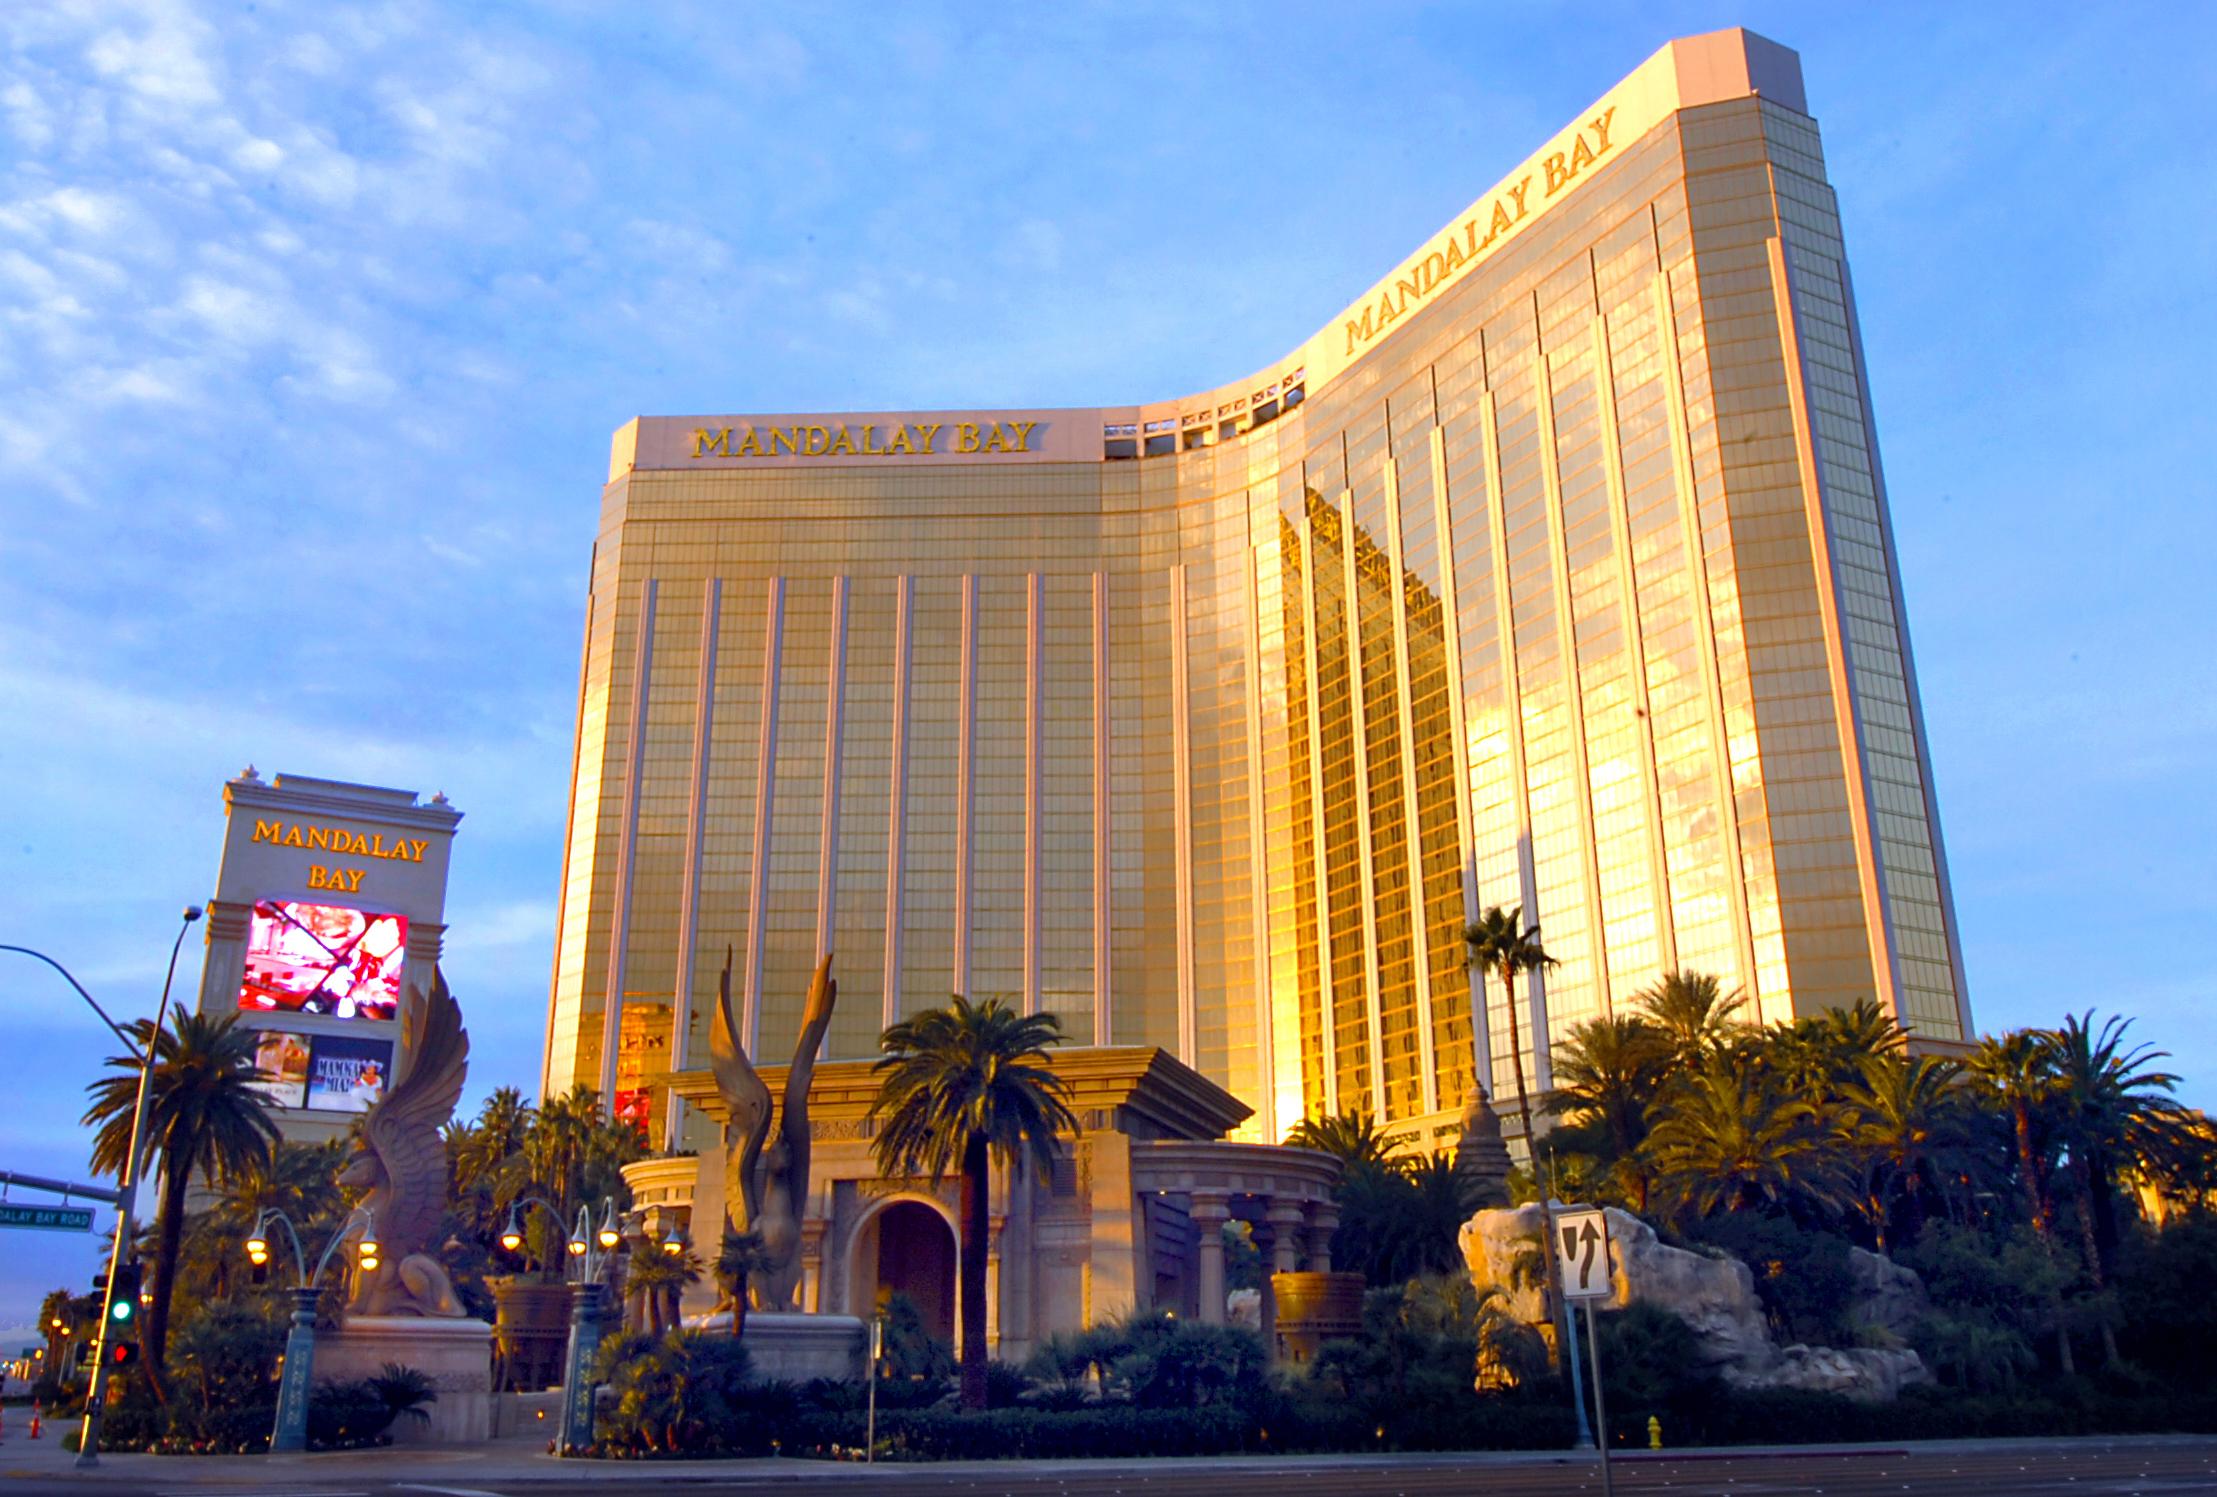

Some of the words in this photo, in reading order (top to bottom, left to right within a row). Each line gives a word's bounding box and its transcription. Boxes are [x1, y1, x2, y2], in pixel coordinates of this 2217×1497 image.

[1344, 174, 1533, 356] MANDALAY
[1541, 105, 1616, 198] BAY
[691, 423, 941, 458] MANDALAY
[954, 421, 1038, 453] BAY
[252, 819, 428, 862] MANDALAY
[307, 864, 366, 892] BAY
[36, 1211, 57, 1224] BAY
[60, 1213, 89, 1226] ROAD
